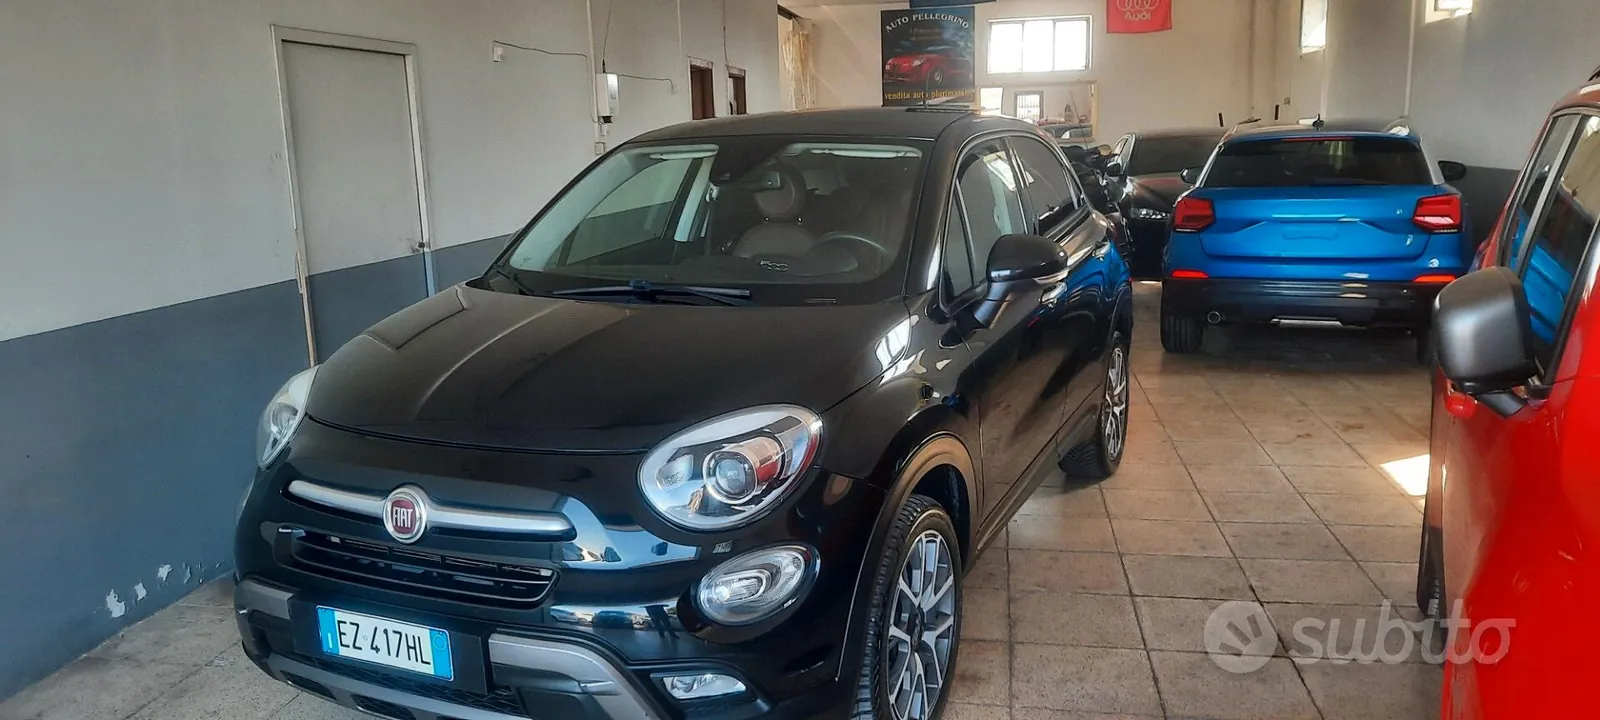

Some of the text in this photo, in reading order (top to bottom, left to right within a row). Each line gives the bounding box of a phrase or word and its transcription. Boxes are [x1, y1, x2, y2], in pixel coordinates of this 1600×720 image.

[885, 13, 969, 33] AUTO PELLEGRINO
[1125, 11, 1150, 20] Audi
[884, 90, 910, 99] vendita
[392, 506, 413, 528] FIAT
[337, 620, 363, 651] EZ
[370, 626, 431, 665] 417HL
